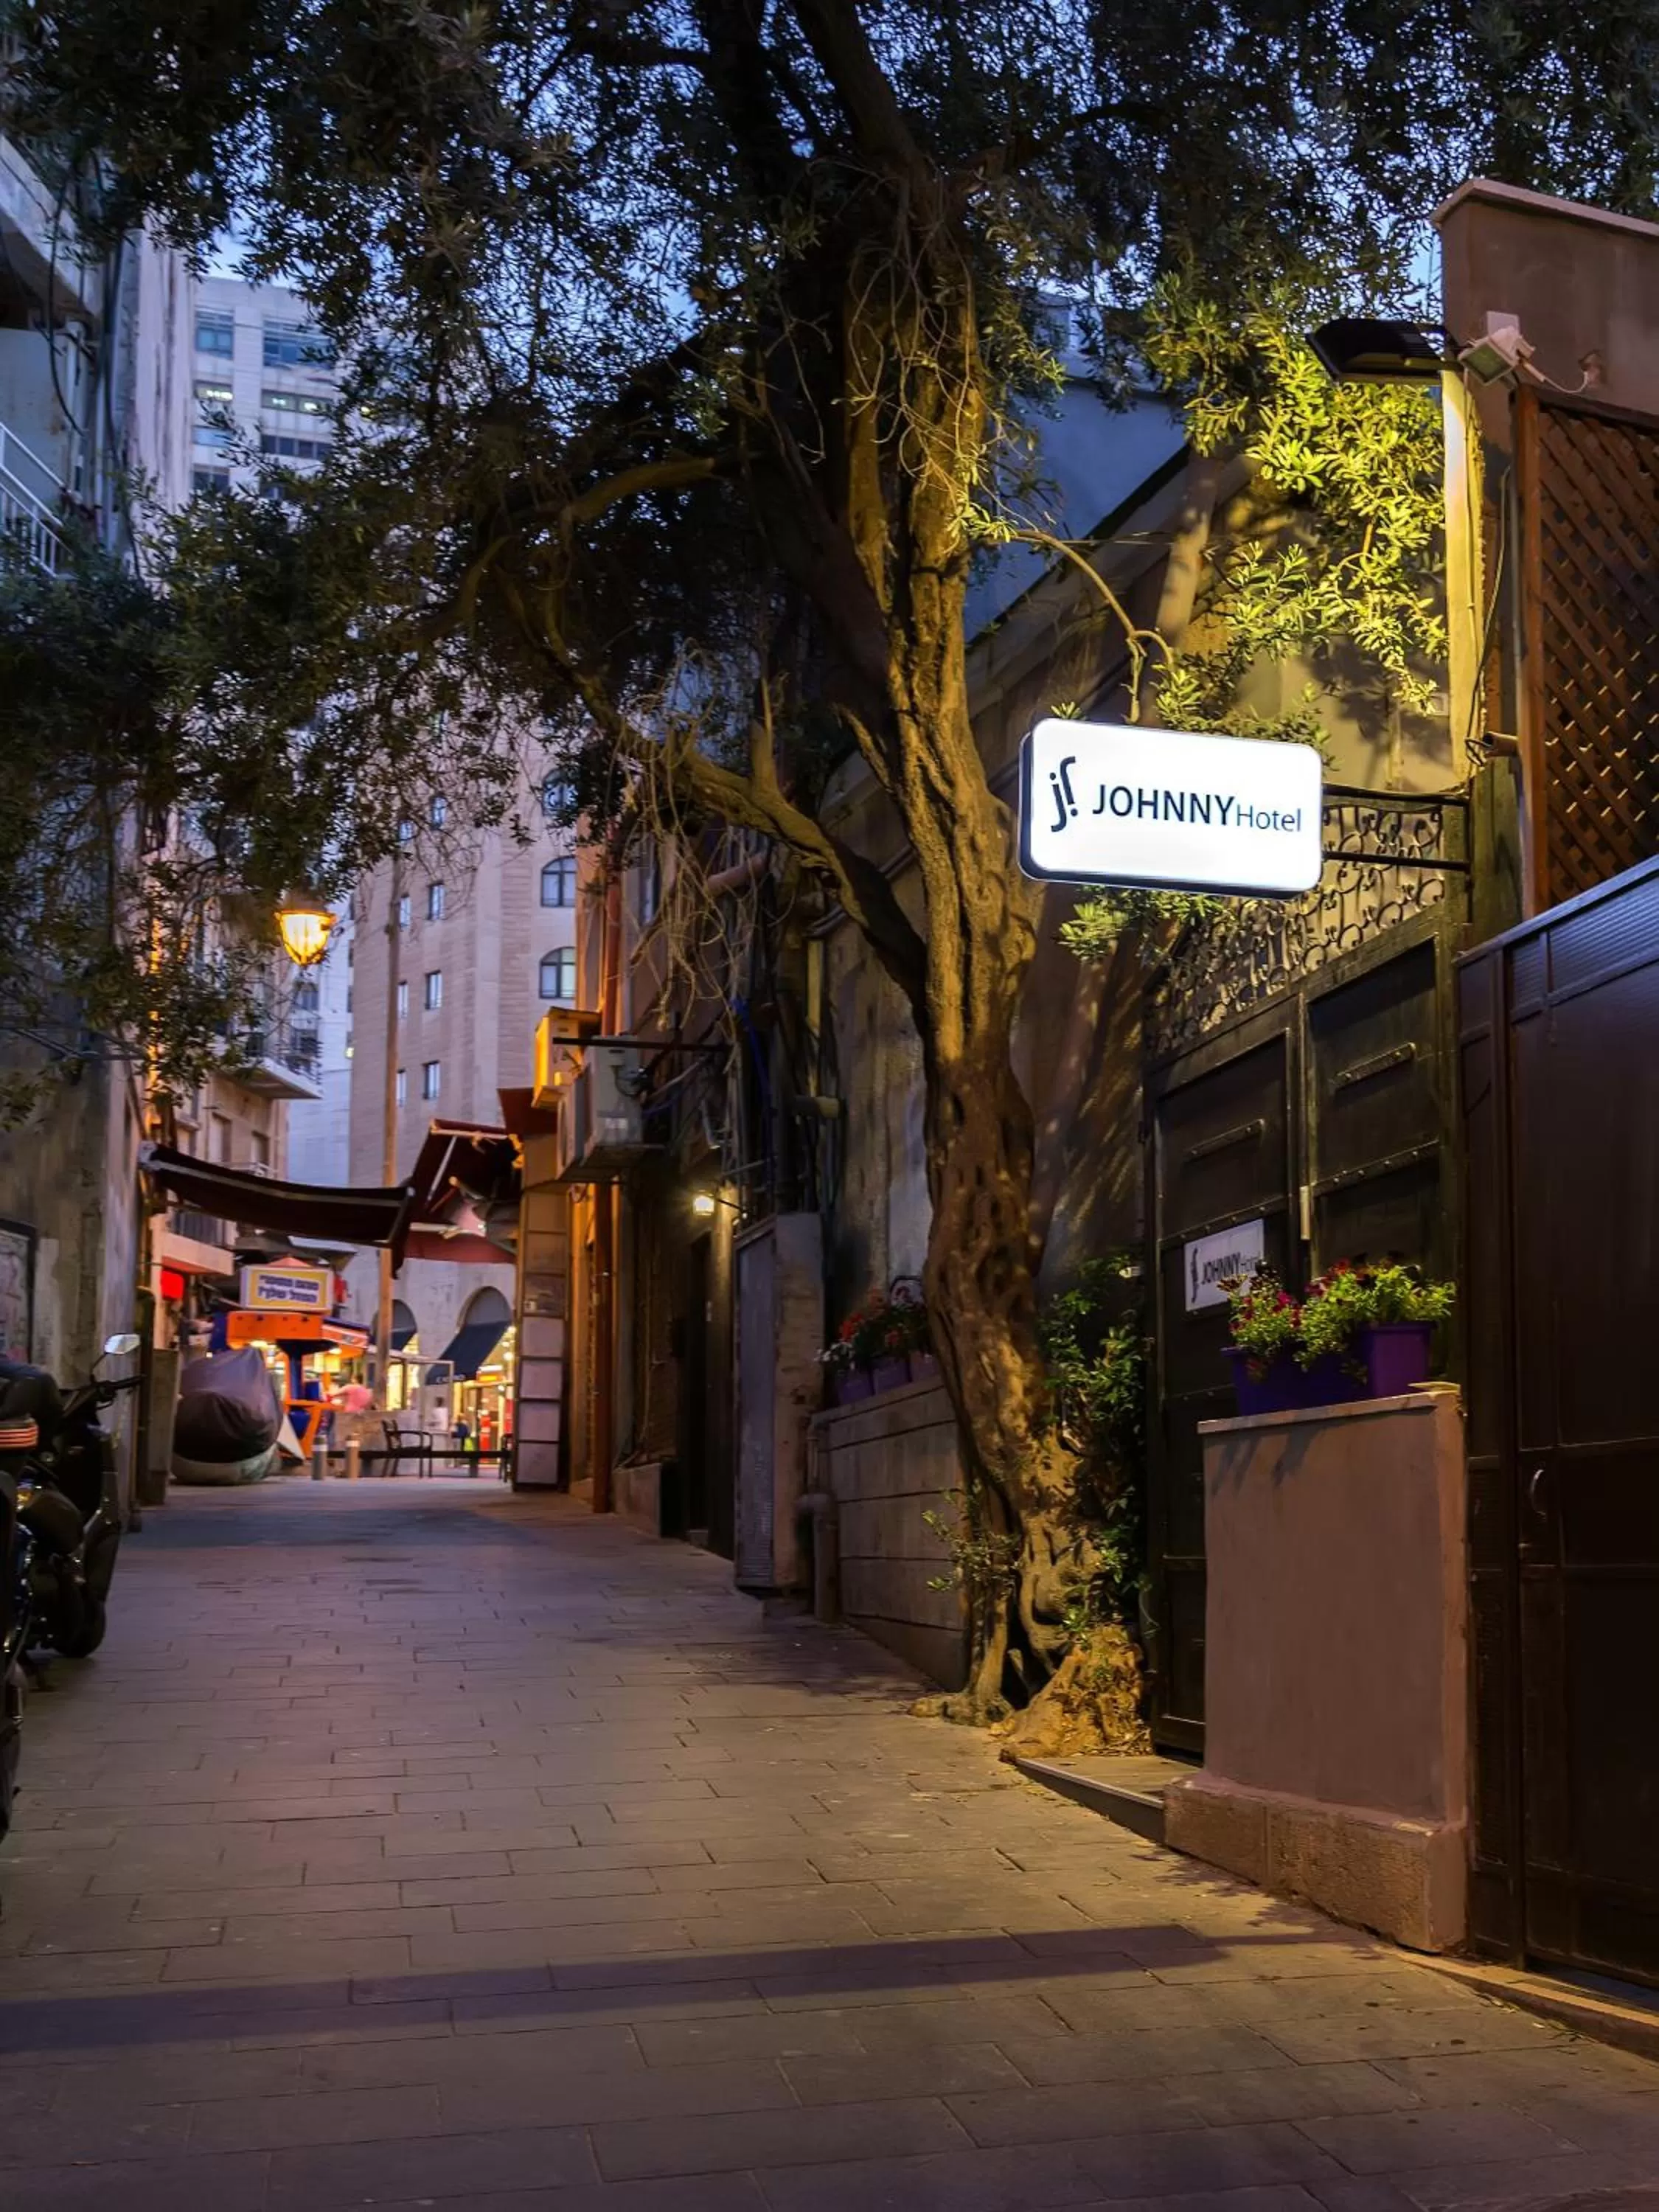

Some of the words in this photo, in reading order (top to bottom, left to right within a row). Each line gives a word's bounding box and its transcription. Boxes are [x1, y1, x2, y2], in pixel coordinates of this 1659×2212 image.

[1092, 784, 1235, 826] JOHNNY
[1237, 804, 1301, 832] Hotel
[1201, 1252, 1241, 1284] JOHNNY
